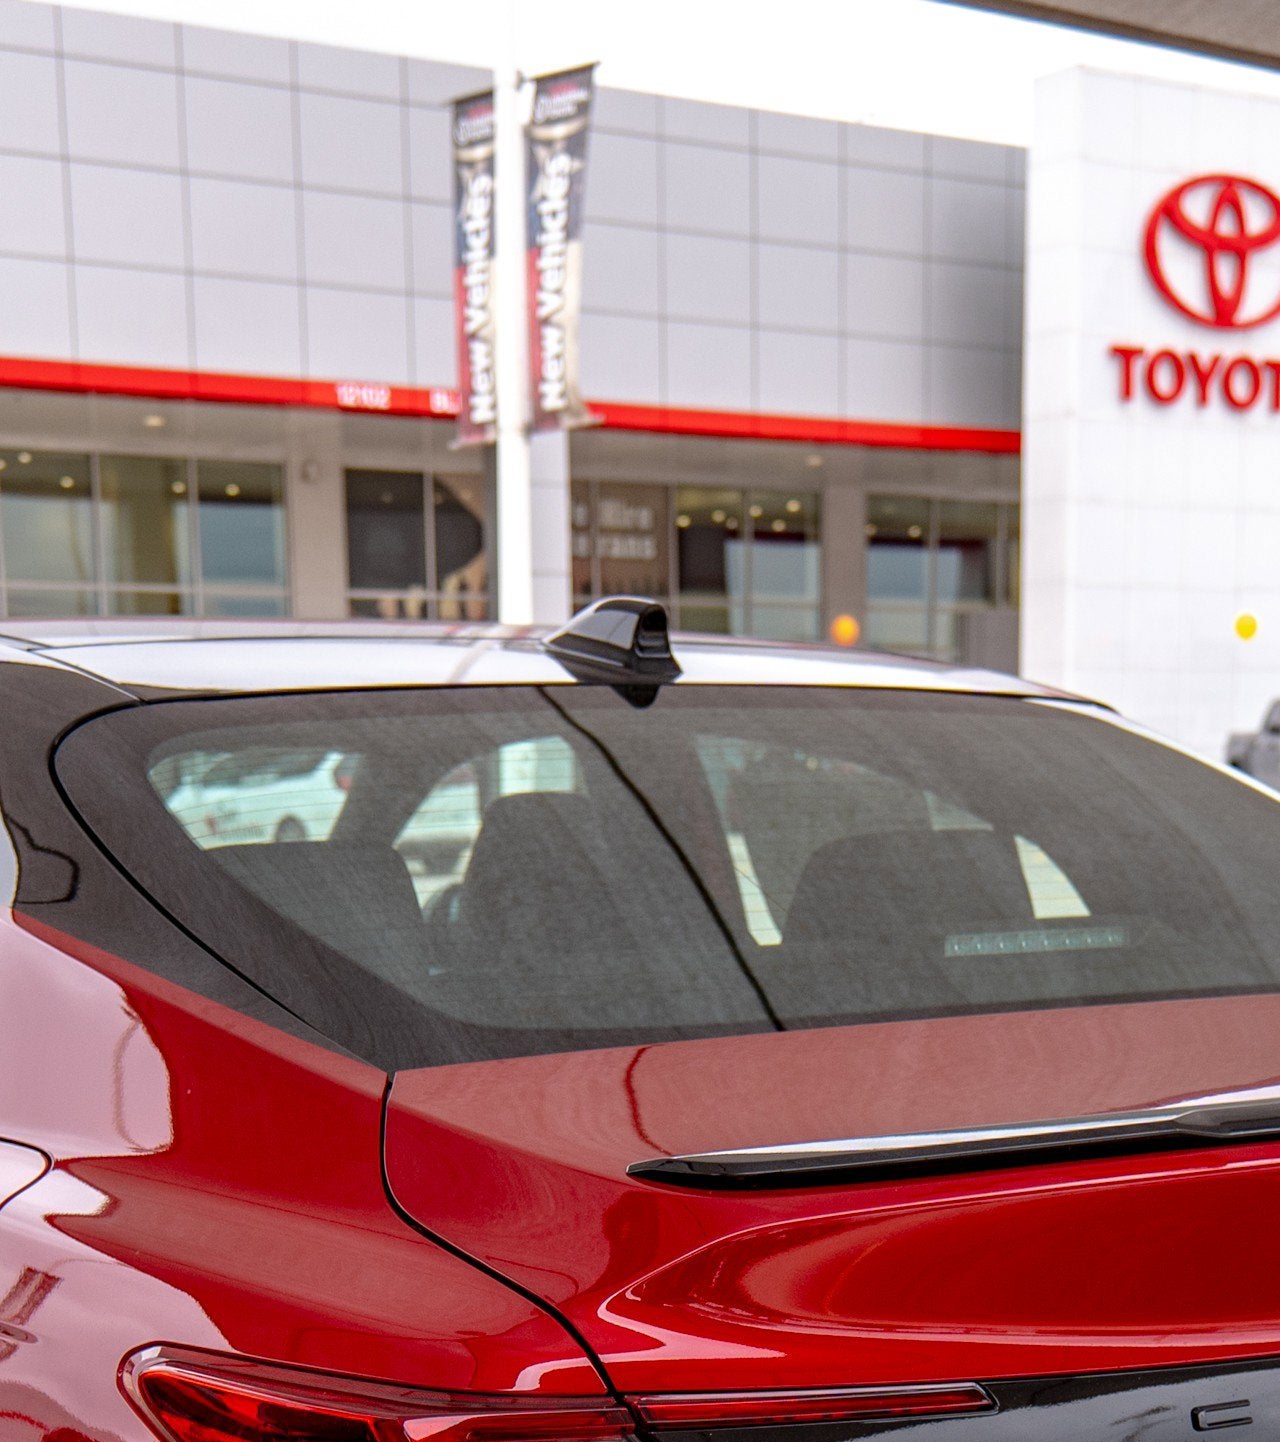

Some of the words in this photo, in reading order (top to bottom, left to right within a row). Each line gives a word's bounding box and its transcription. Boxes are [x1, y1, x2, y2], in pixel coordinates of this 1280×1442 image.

[463, 174, 493, 337] Vehicles
[536, 153, 571, 320] Vehicles
[470, 339, 495, 425] New
[539, 324, 569, 412] New
